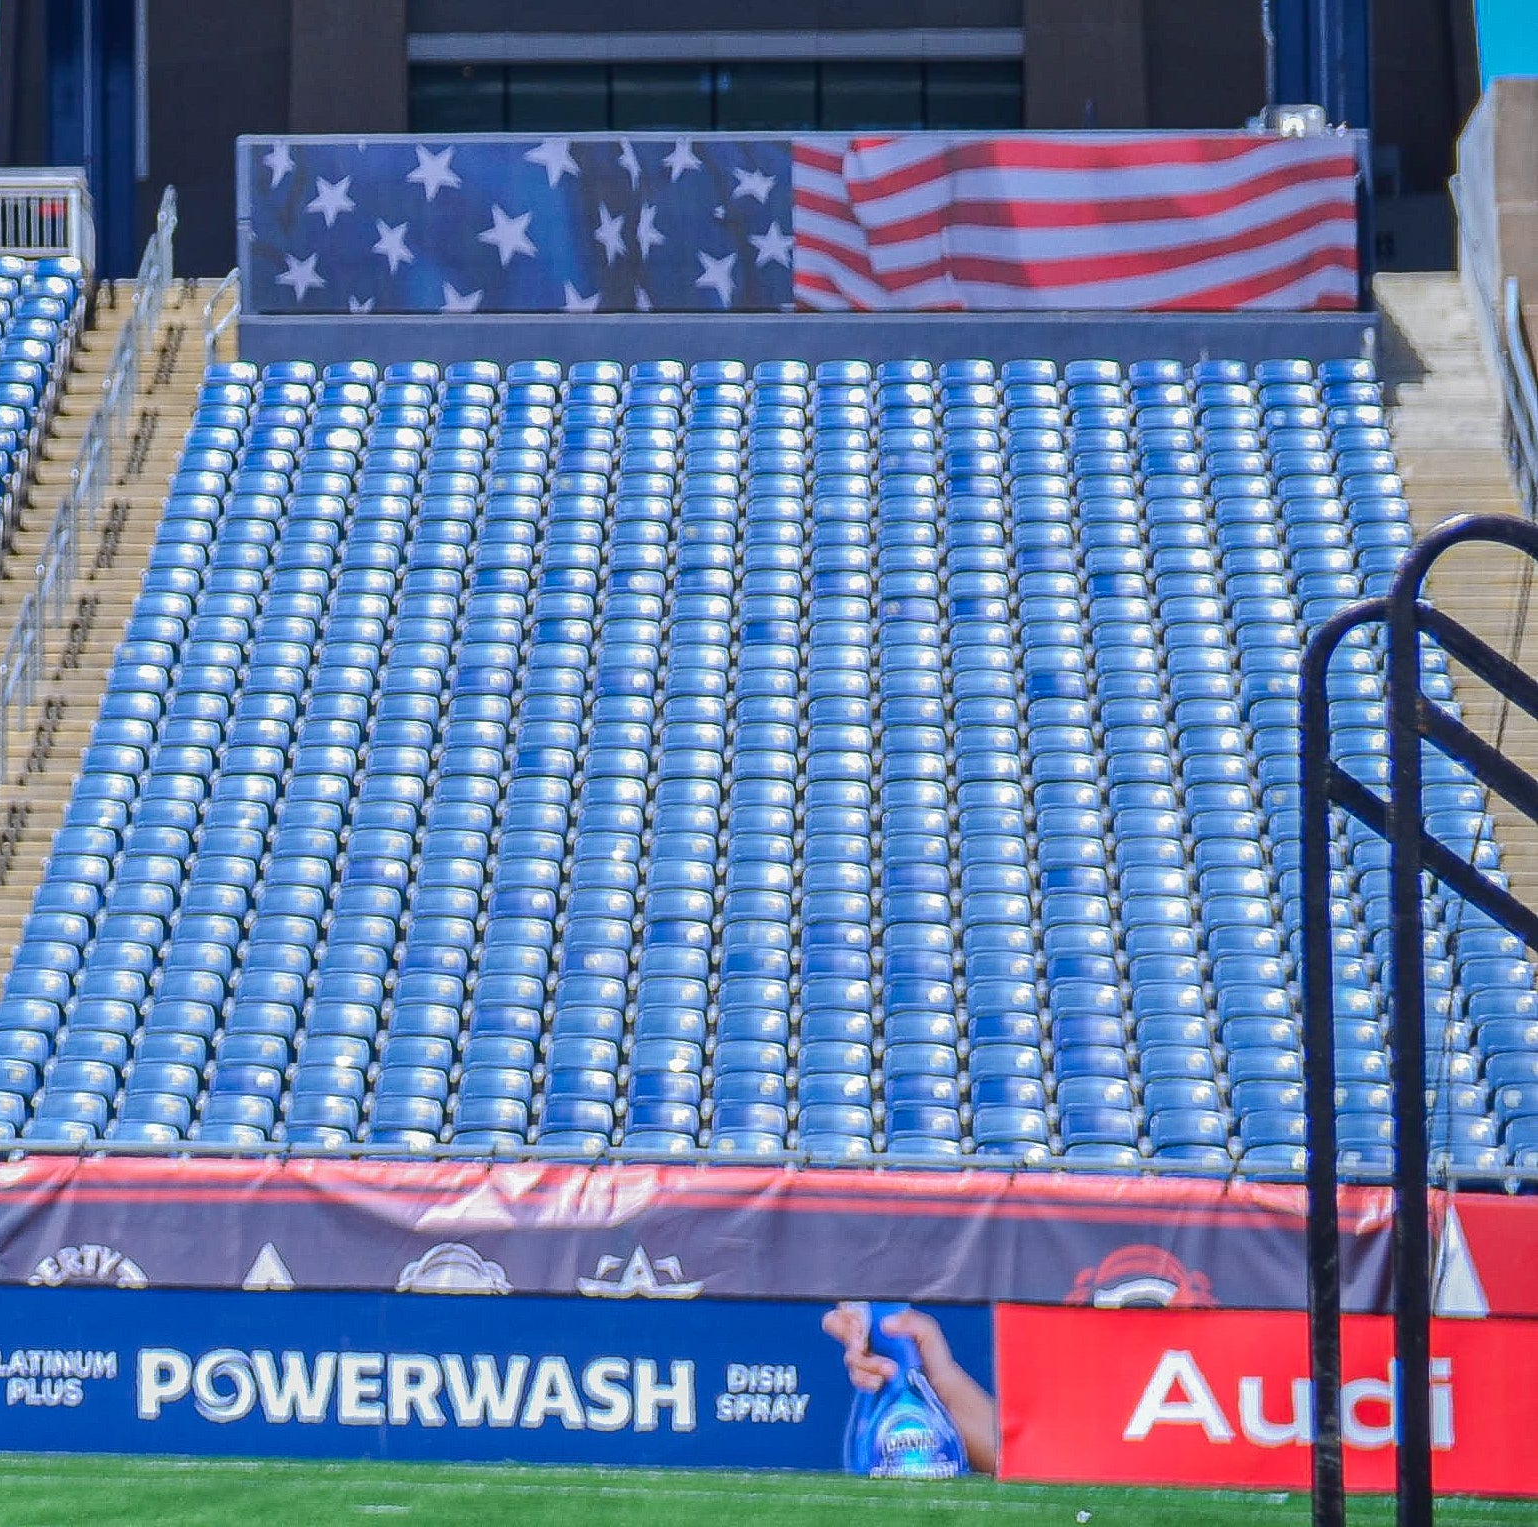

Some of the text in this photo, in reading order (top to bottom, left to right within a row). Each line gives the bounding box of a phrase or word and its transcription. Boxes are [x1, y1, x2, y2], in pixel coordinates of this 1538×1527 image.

[6, 1377, 84, 1407] PLUS
[136, 1347, 697, 1433] POWERWASH
[726, 1362, 798, 1393] DISH
[715, 1392, 811, 1423] SPRAY
[1122, 1348, 1457, 1452] Audi
